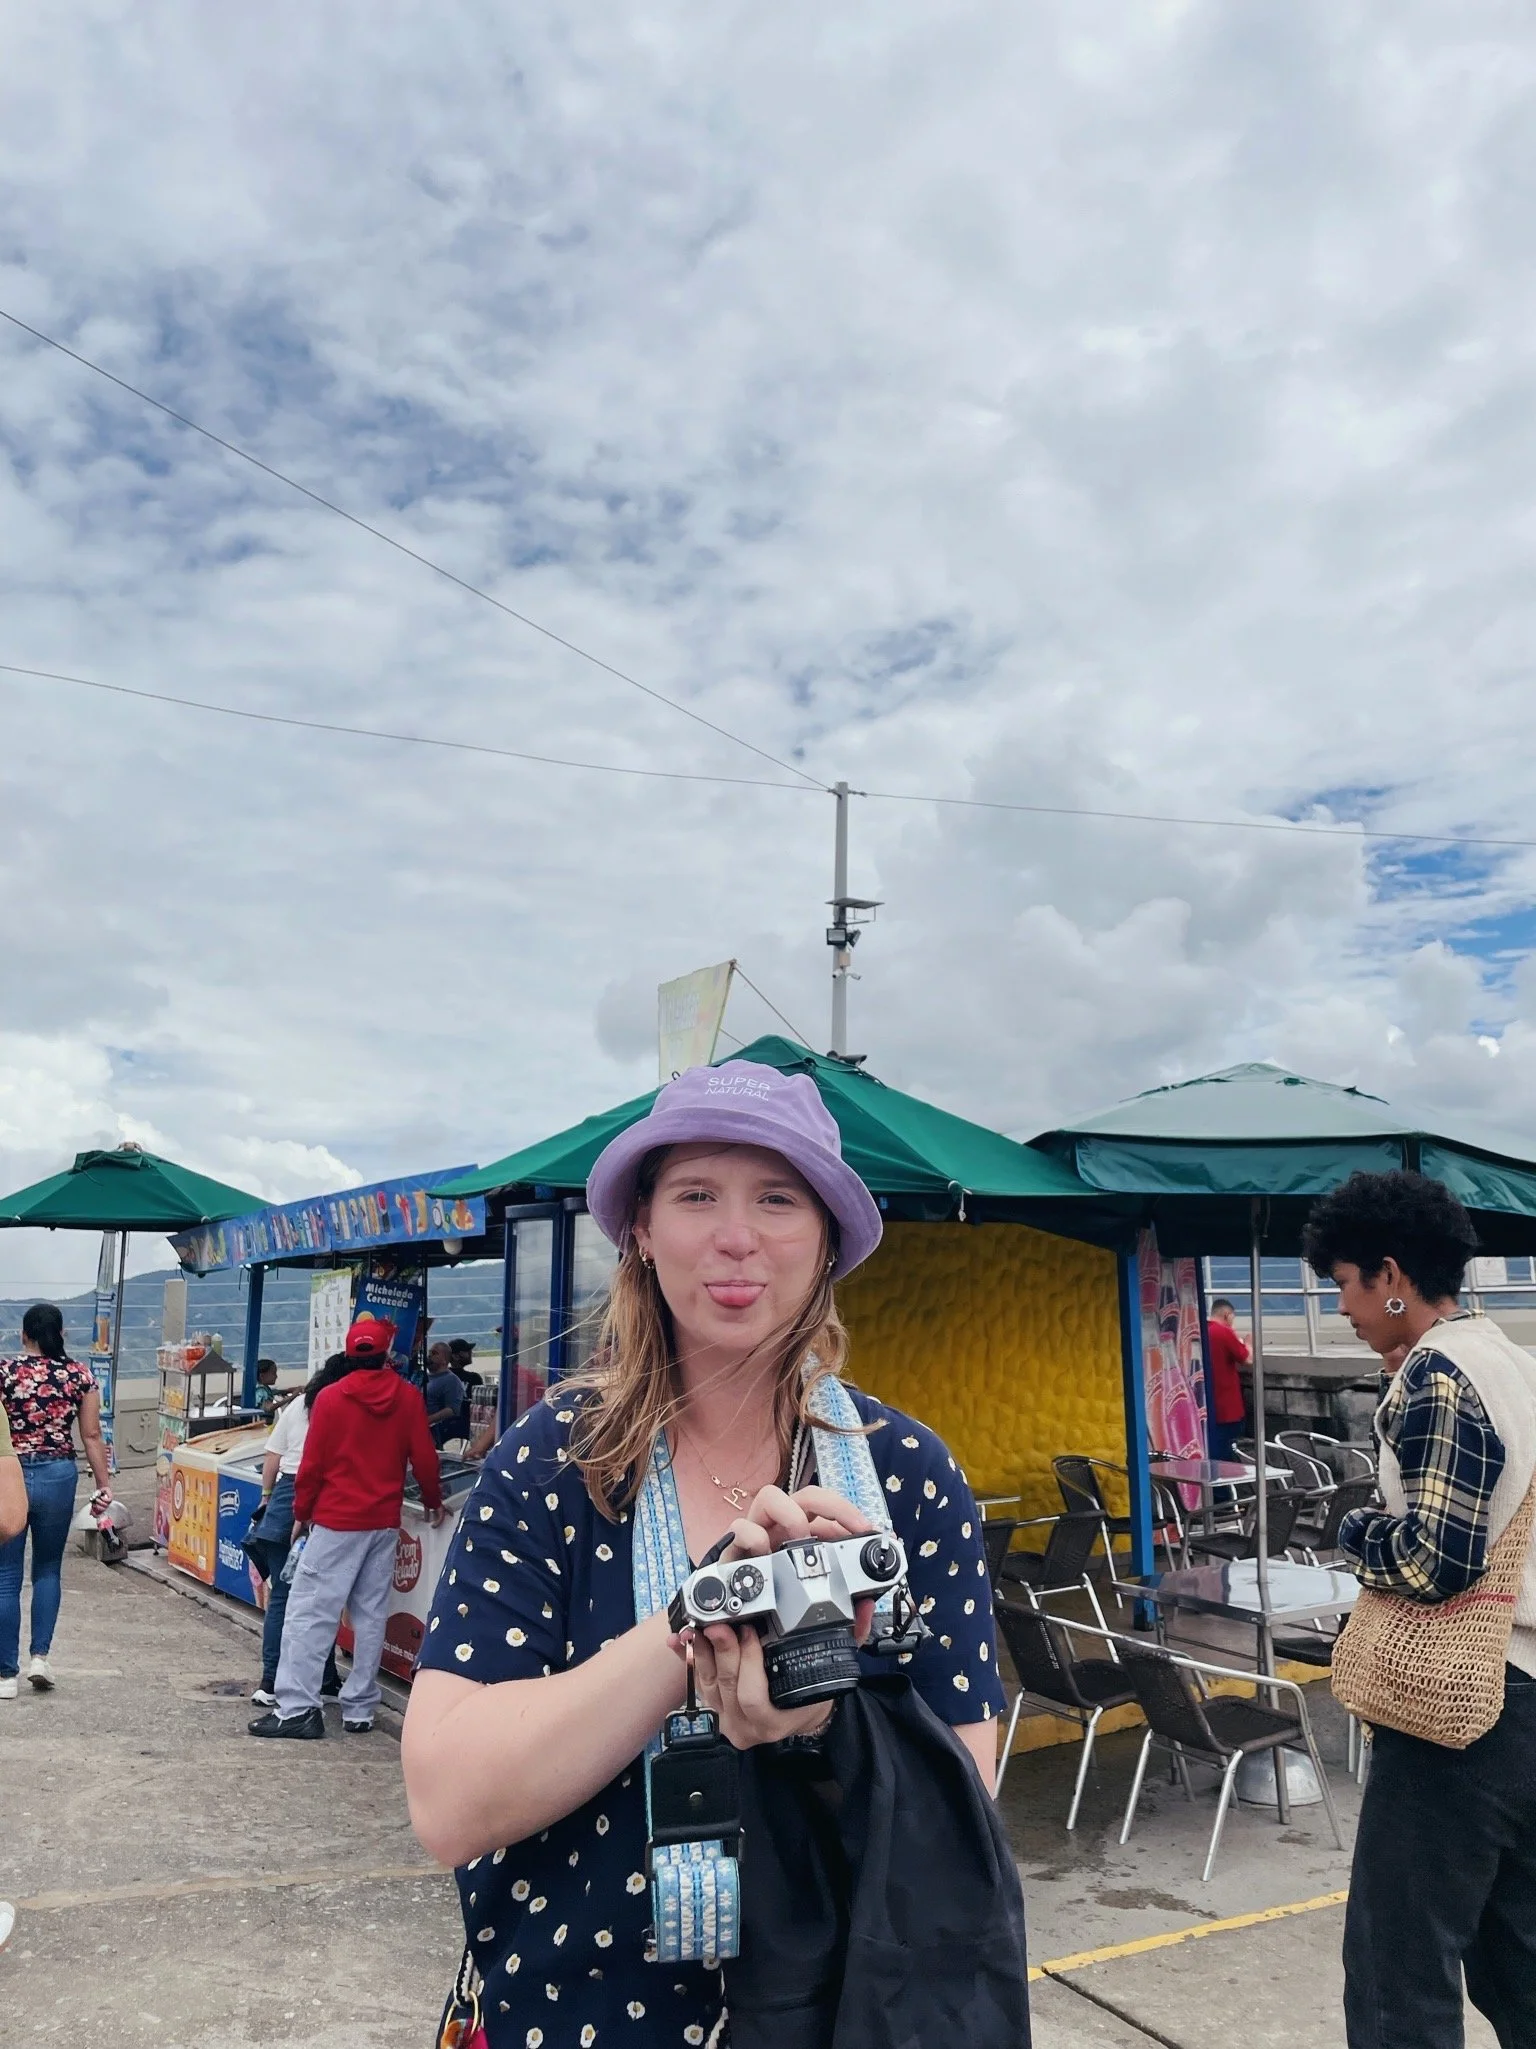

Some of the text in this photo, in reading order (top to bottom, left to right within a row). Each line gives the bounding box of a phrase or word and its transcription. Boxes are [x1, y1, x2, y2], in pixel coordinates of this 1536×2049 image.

[708, 1077, 770, 1091] SUPER
[705, 1086, 769, 1102] NATURAL
[365, 1282, 414, 1300] Michelada
[366, 1293, 409, 1309] Cerezada
